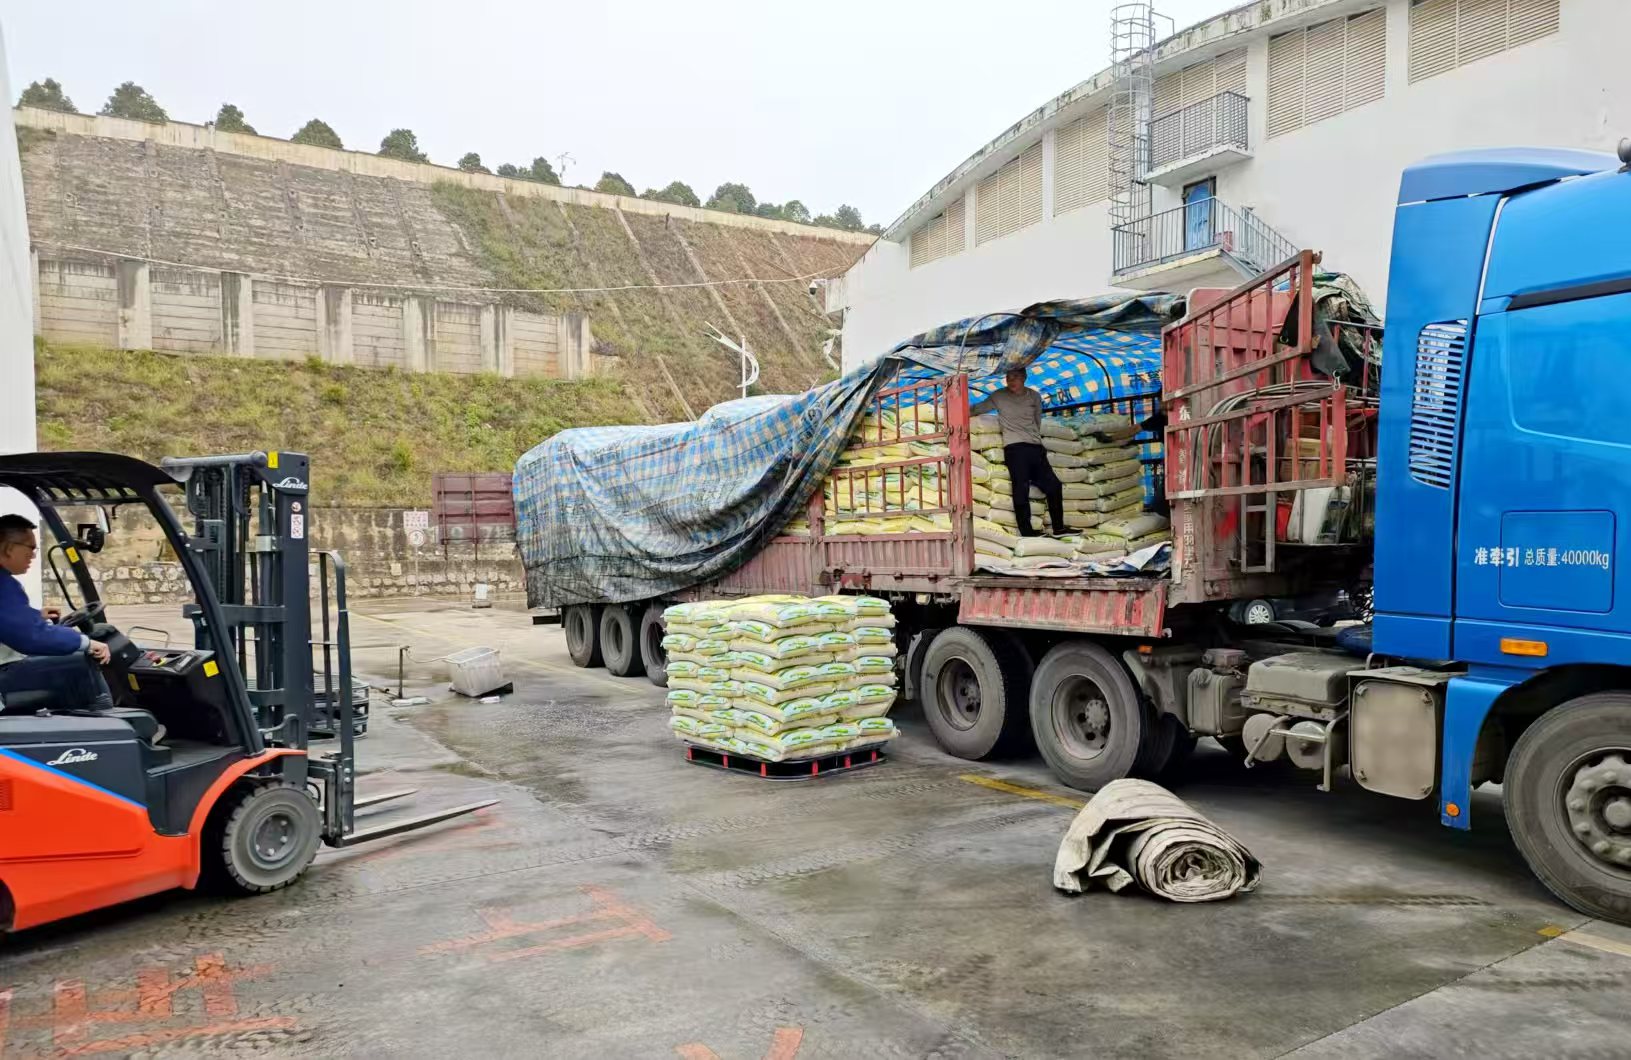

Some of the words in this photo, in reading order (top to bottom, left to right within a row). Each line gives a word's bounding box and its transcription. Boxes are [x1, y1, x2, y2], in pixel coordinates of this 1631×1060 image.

[272, 477, 308, 490] Linde
[1474, 546, 1520, 568] 准牵引
[1524, 547, 1610, 570] 总质量:40000kg
[46, 748, 98, 766] Linde
